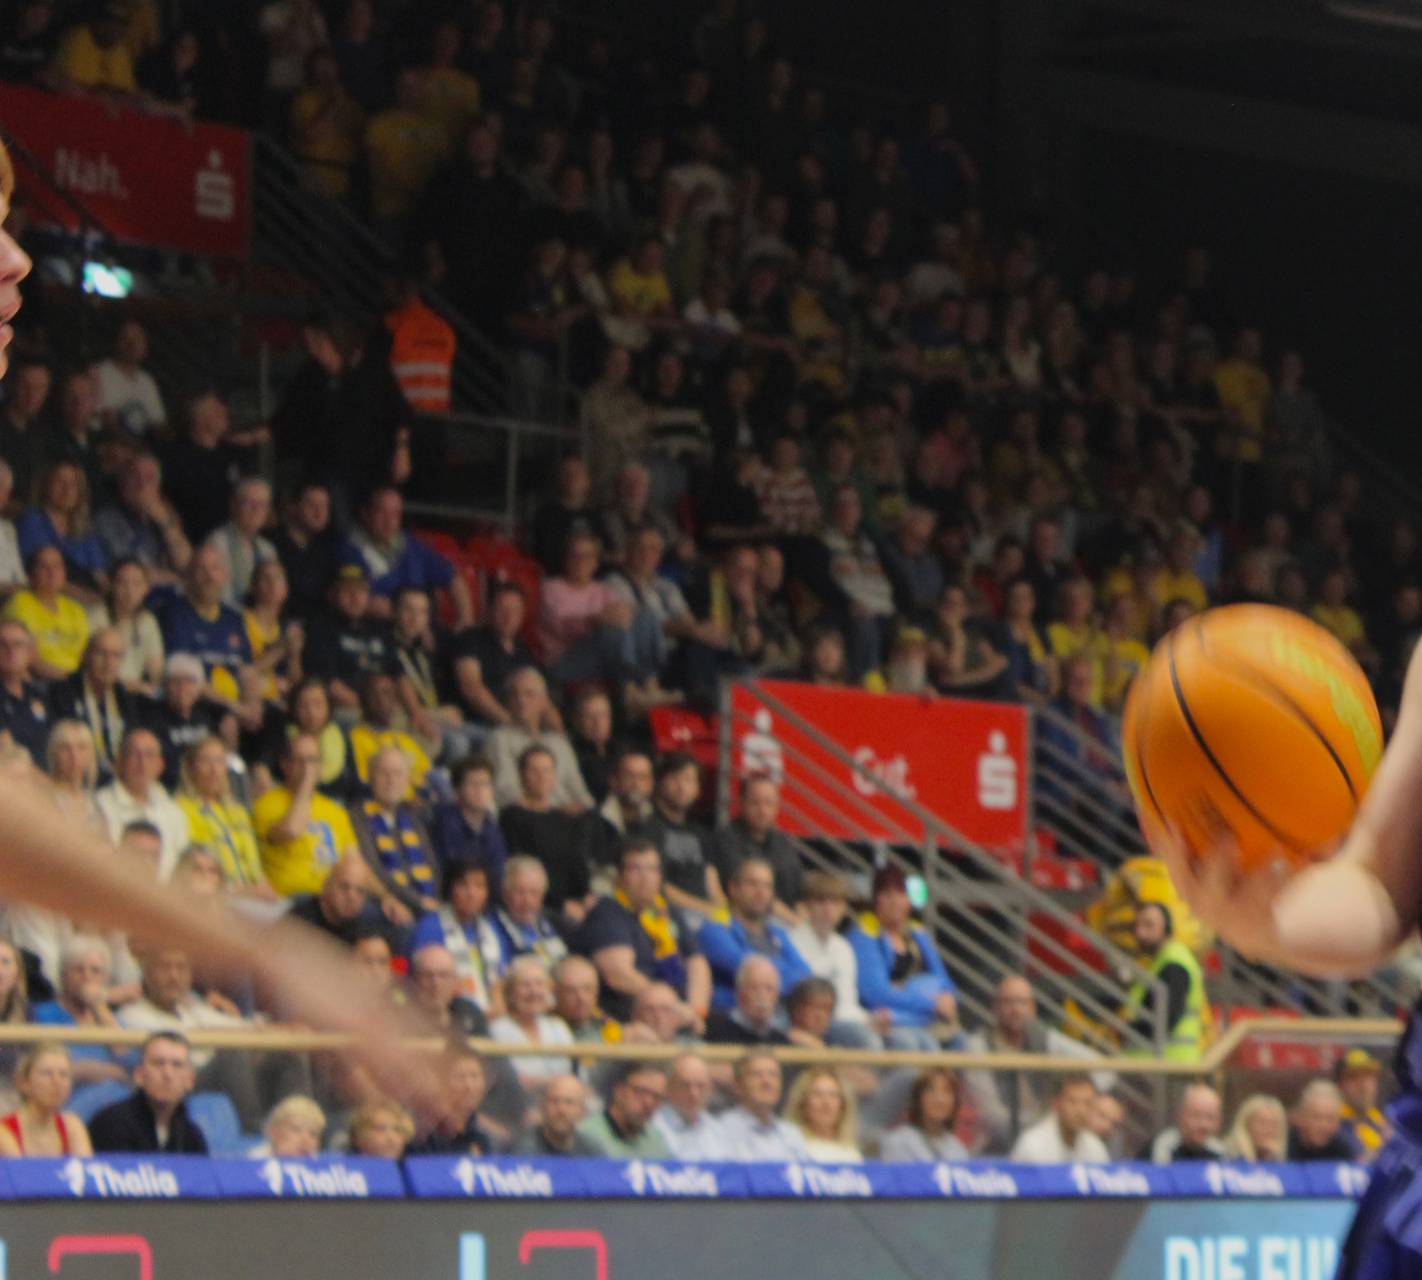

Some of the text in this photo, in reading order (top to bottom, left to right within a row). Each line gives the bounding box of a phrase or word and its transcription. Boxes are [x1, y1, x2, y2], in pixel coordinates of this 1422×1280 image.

[87, 1162, 180, 1198] Thalia
[281, 1162, 368, 1198] Thalia
[473, 1163, 553, 1197] Thalia
[1164, 1236, 1247, 1280] DIE
